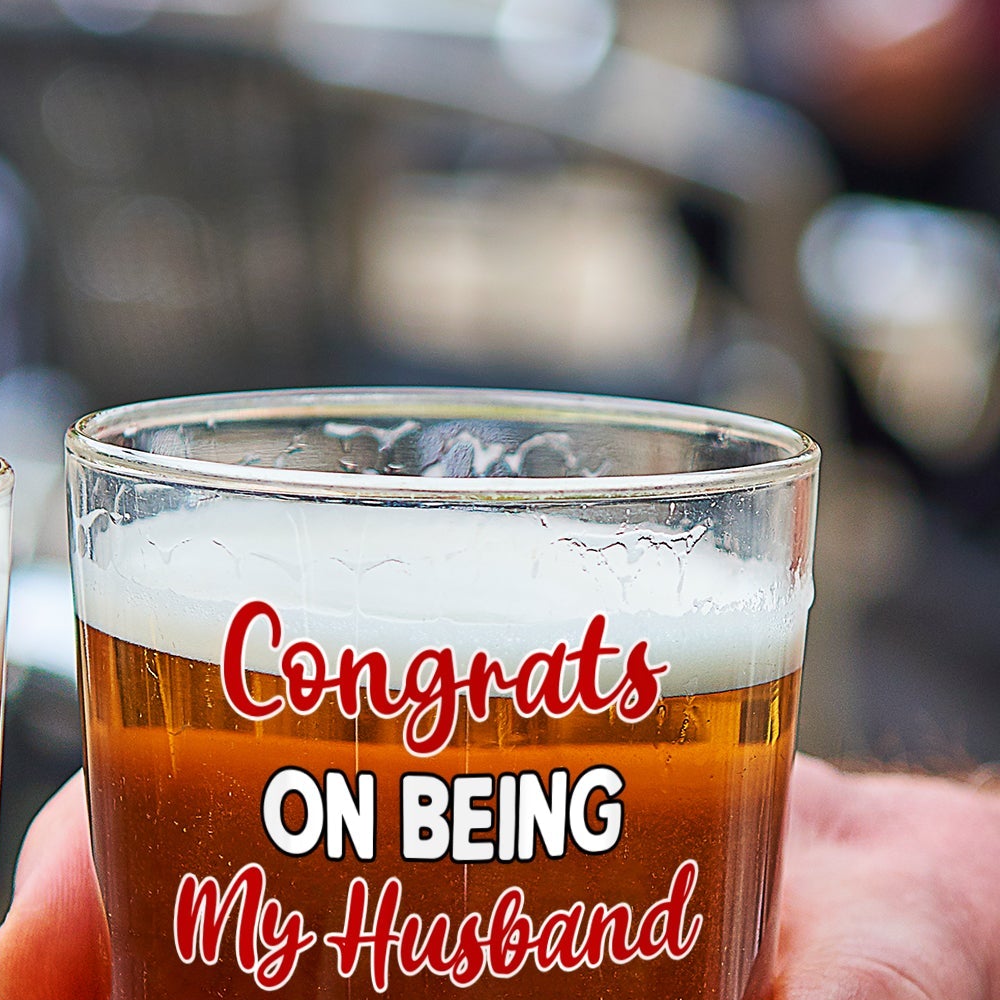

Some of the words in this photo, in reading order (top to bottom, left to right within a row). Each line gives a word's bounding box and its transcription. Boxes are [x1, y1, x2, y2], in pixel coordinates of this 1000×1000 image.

[220, 598, 669, 757] Congrats
[260, 765, 376, 862] ON
[400, 765, 625, 863] BEING
[174, 862, 316, 990] My
[323, 859, 703, 993] Husband
